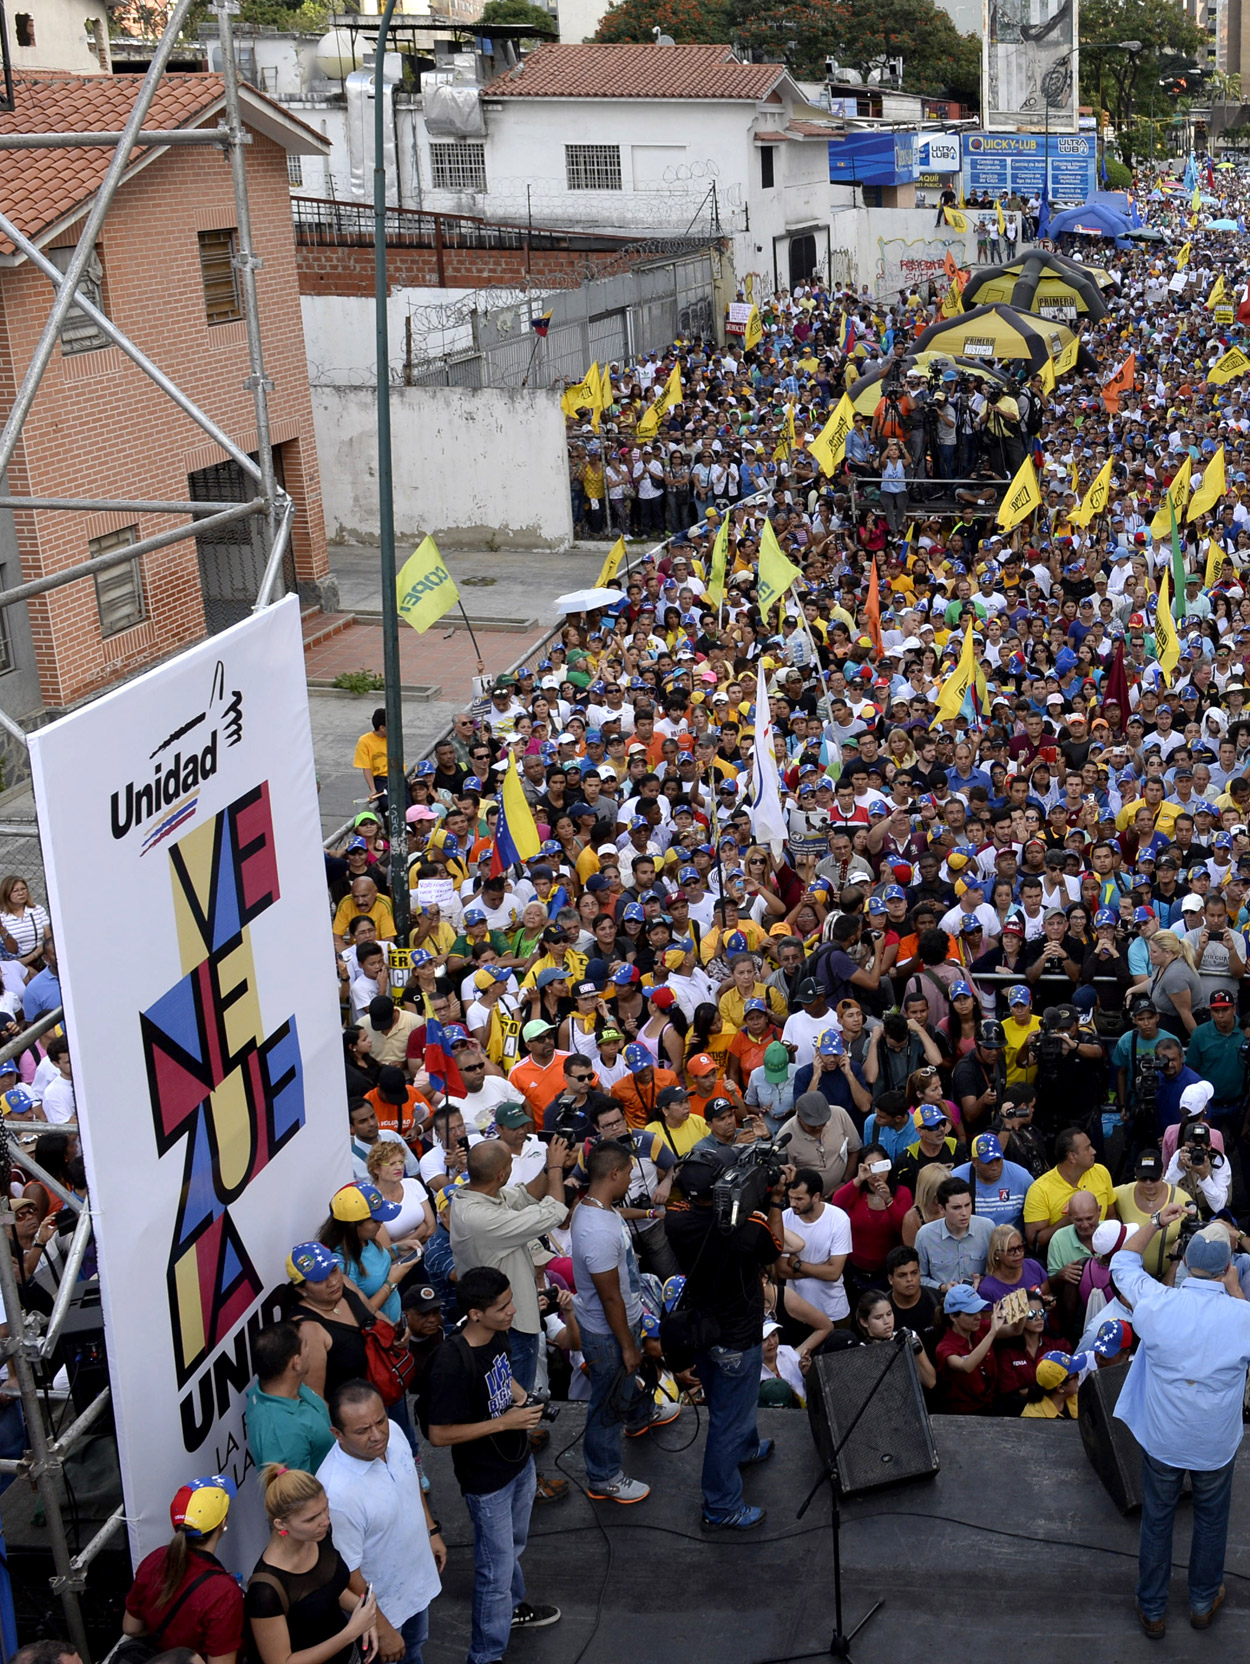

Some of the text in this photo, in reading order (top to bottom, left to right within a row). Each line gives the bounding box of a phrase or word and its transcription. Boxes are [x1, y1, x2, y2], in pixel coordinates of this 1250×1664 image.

[969, 136, 1037, 152] QUICKY-LUB
[1058, 138, 1087, 146] ULTRA
[1059, 145, 1080, 153] LUB
[1039, 296, 1076, 307] PRIMERO
[964, 336, 996, 346] PRIMERO
[110, 730, 218, 840] Unidad
[216, 1431, 239, 1475] LA
